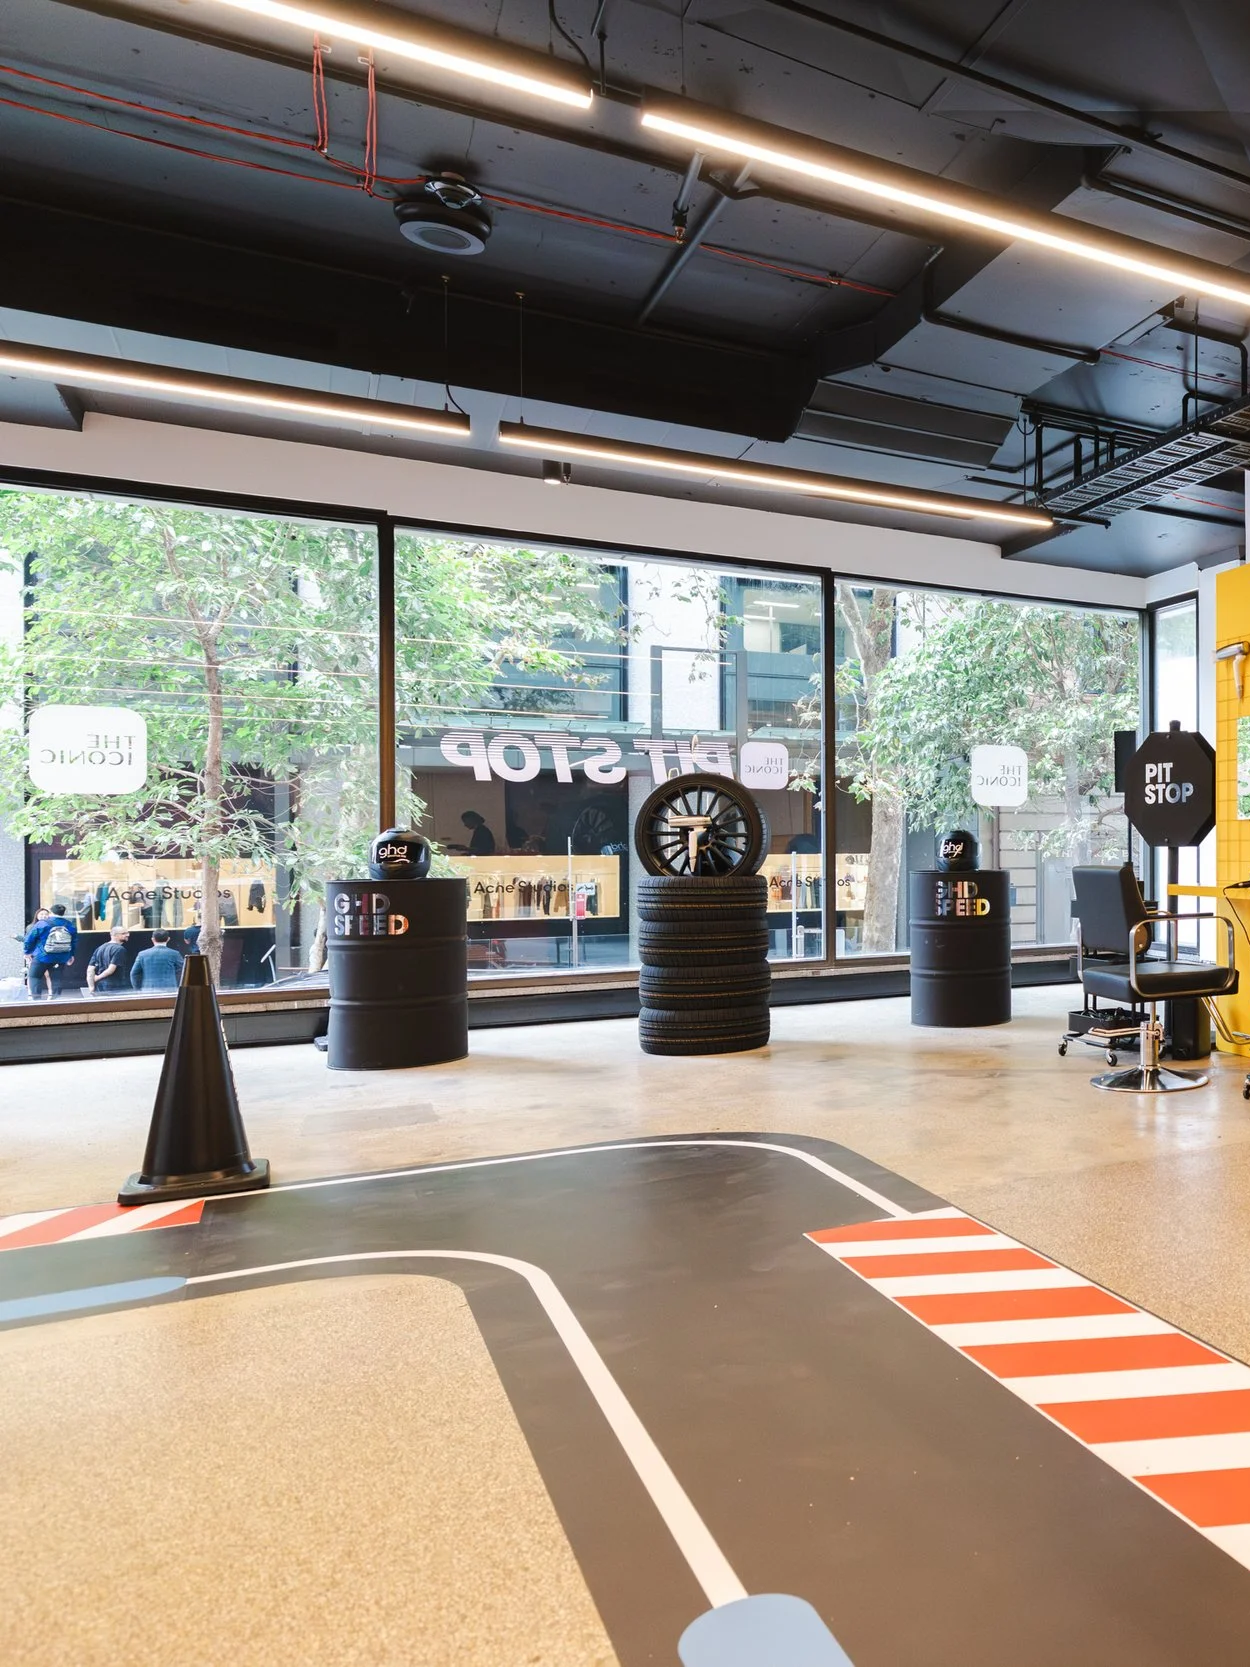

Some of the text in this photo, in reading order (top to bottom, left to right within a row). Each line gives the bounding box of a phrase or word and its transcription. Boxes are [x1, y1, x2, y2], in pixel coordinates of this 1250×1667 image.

[1145, 762, 1174, 784] PIT
[1144, 782, 1194, 805] STOP
[378, 843, 408, 859] ghd
[107, 887, 158, 901] Acne
[473, 881, 516, 894] Acne
[935, 880, 979, 899] GHD
[334, 892, 391, 915] GHD
[935, 898, 991, 916] SPEED
